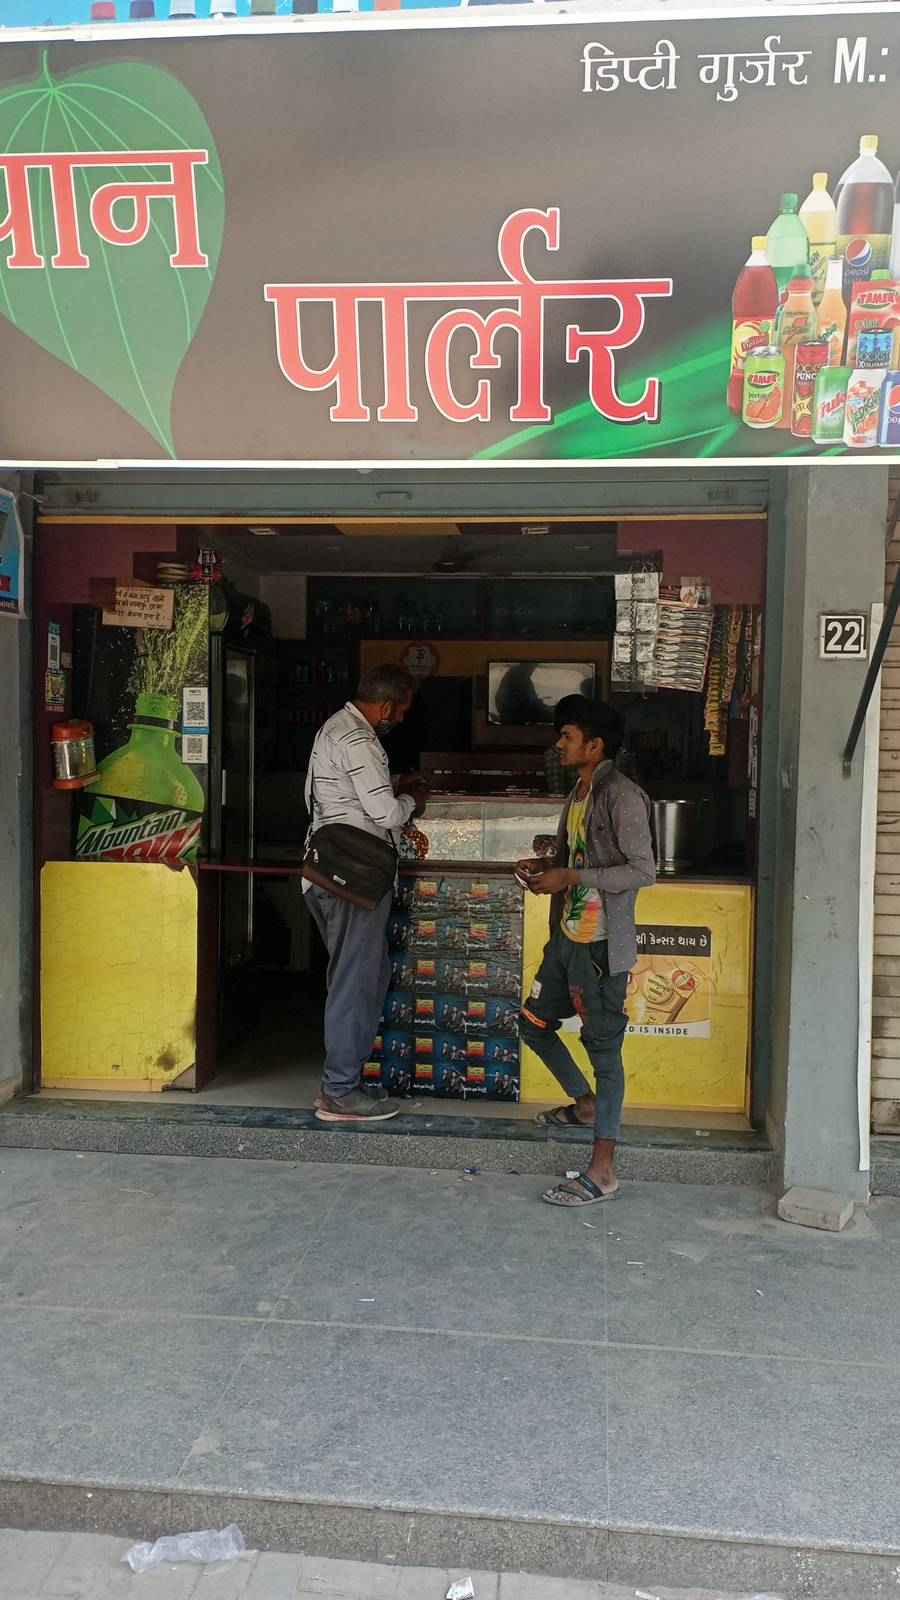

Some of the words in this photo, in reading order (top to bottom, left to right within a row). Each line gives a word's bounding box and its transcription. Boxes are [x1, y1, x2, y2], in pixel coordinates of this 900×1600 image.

[580, 39, 681, 93] डिप्टी
[697, 35, 813, 103] गुर्जर
[264, 207, 673, 425] पार्लर
[826, 621, 860, 651] 22
[77, 811, 182, 855] Mountain
[654, 1027, 689, 1035] INSIDE
